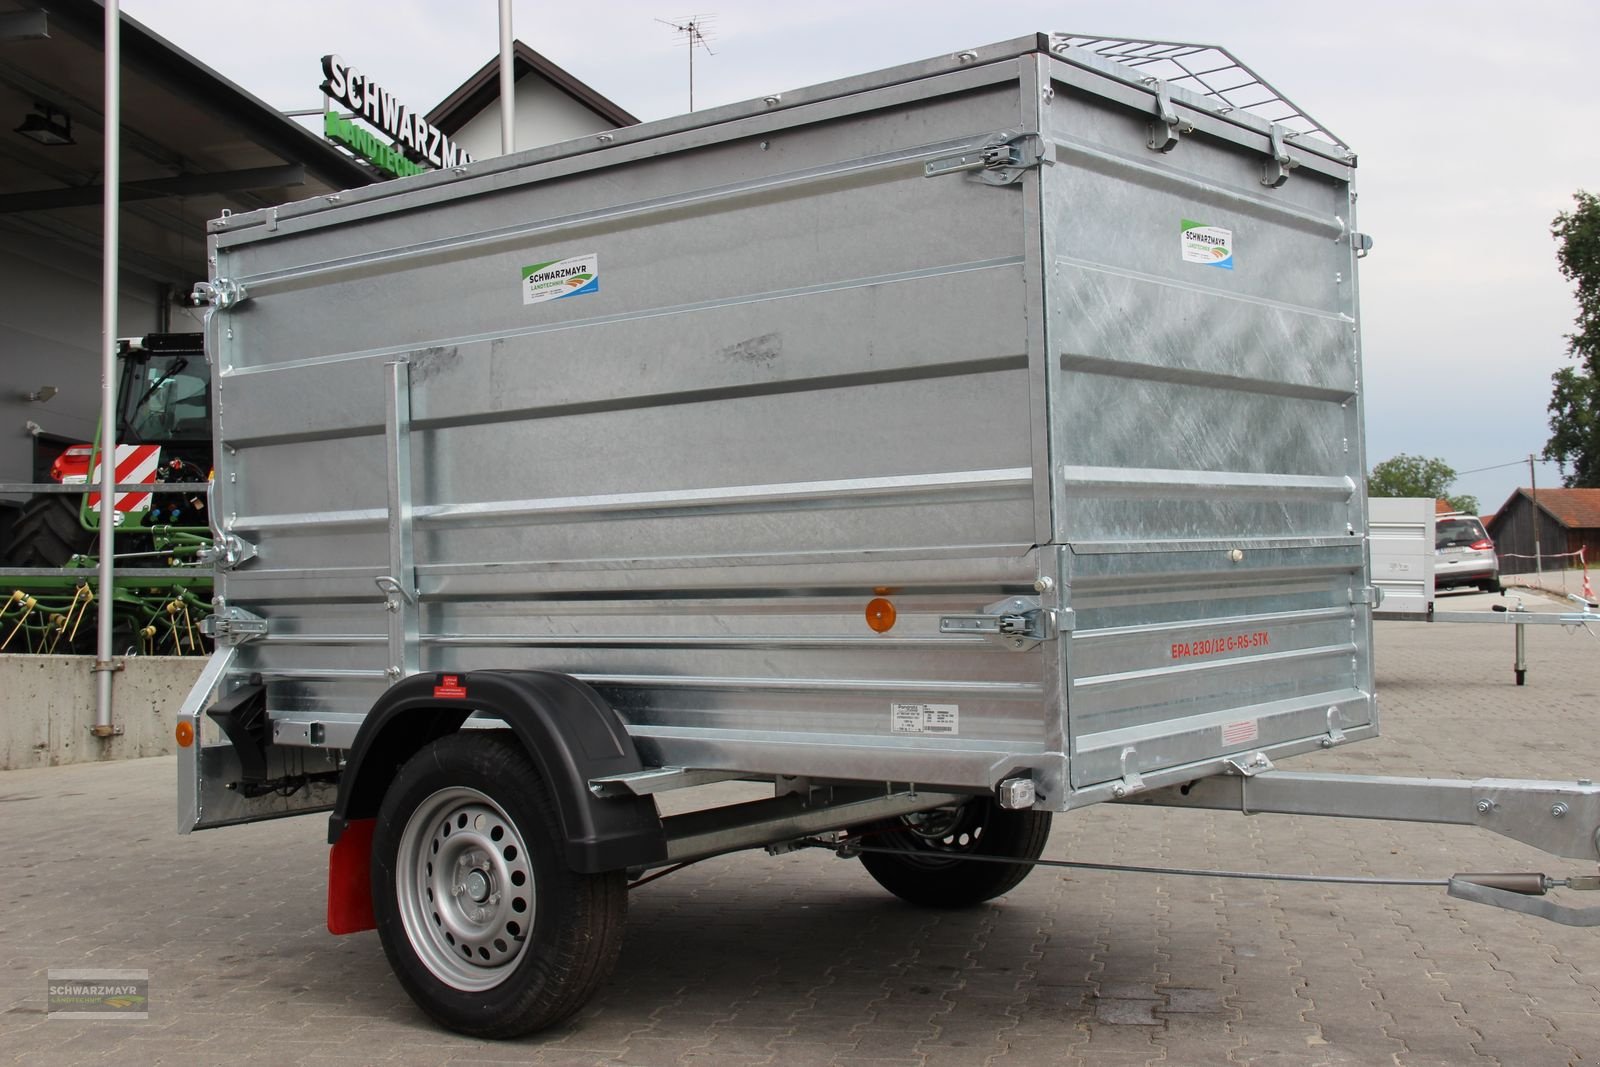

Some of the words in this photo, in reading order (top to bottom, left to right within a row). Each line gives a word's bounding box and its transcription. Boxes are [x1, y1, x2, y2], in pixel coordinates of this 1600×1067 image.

[321, 53, 472, 169] SCHWARZMA
[326, 111, 424, 176] LANDTECH
[1185, 231, 1226, 246] SCHWARZMAYR
[529, 265, 587, 284] SCHWARZMAYR
[530, 280, 564, 291] LANDTECHNIK
[1171, 643, 1191, 659] EPA
[1192, 638, 1225, 656] 230/12
[1227, 632, 1269, 650] G-RS-STK
